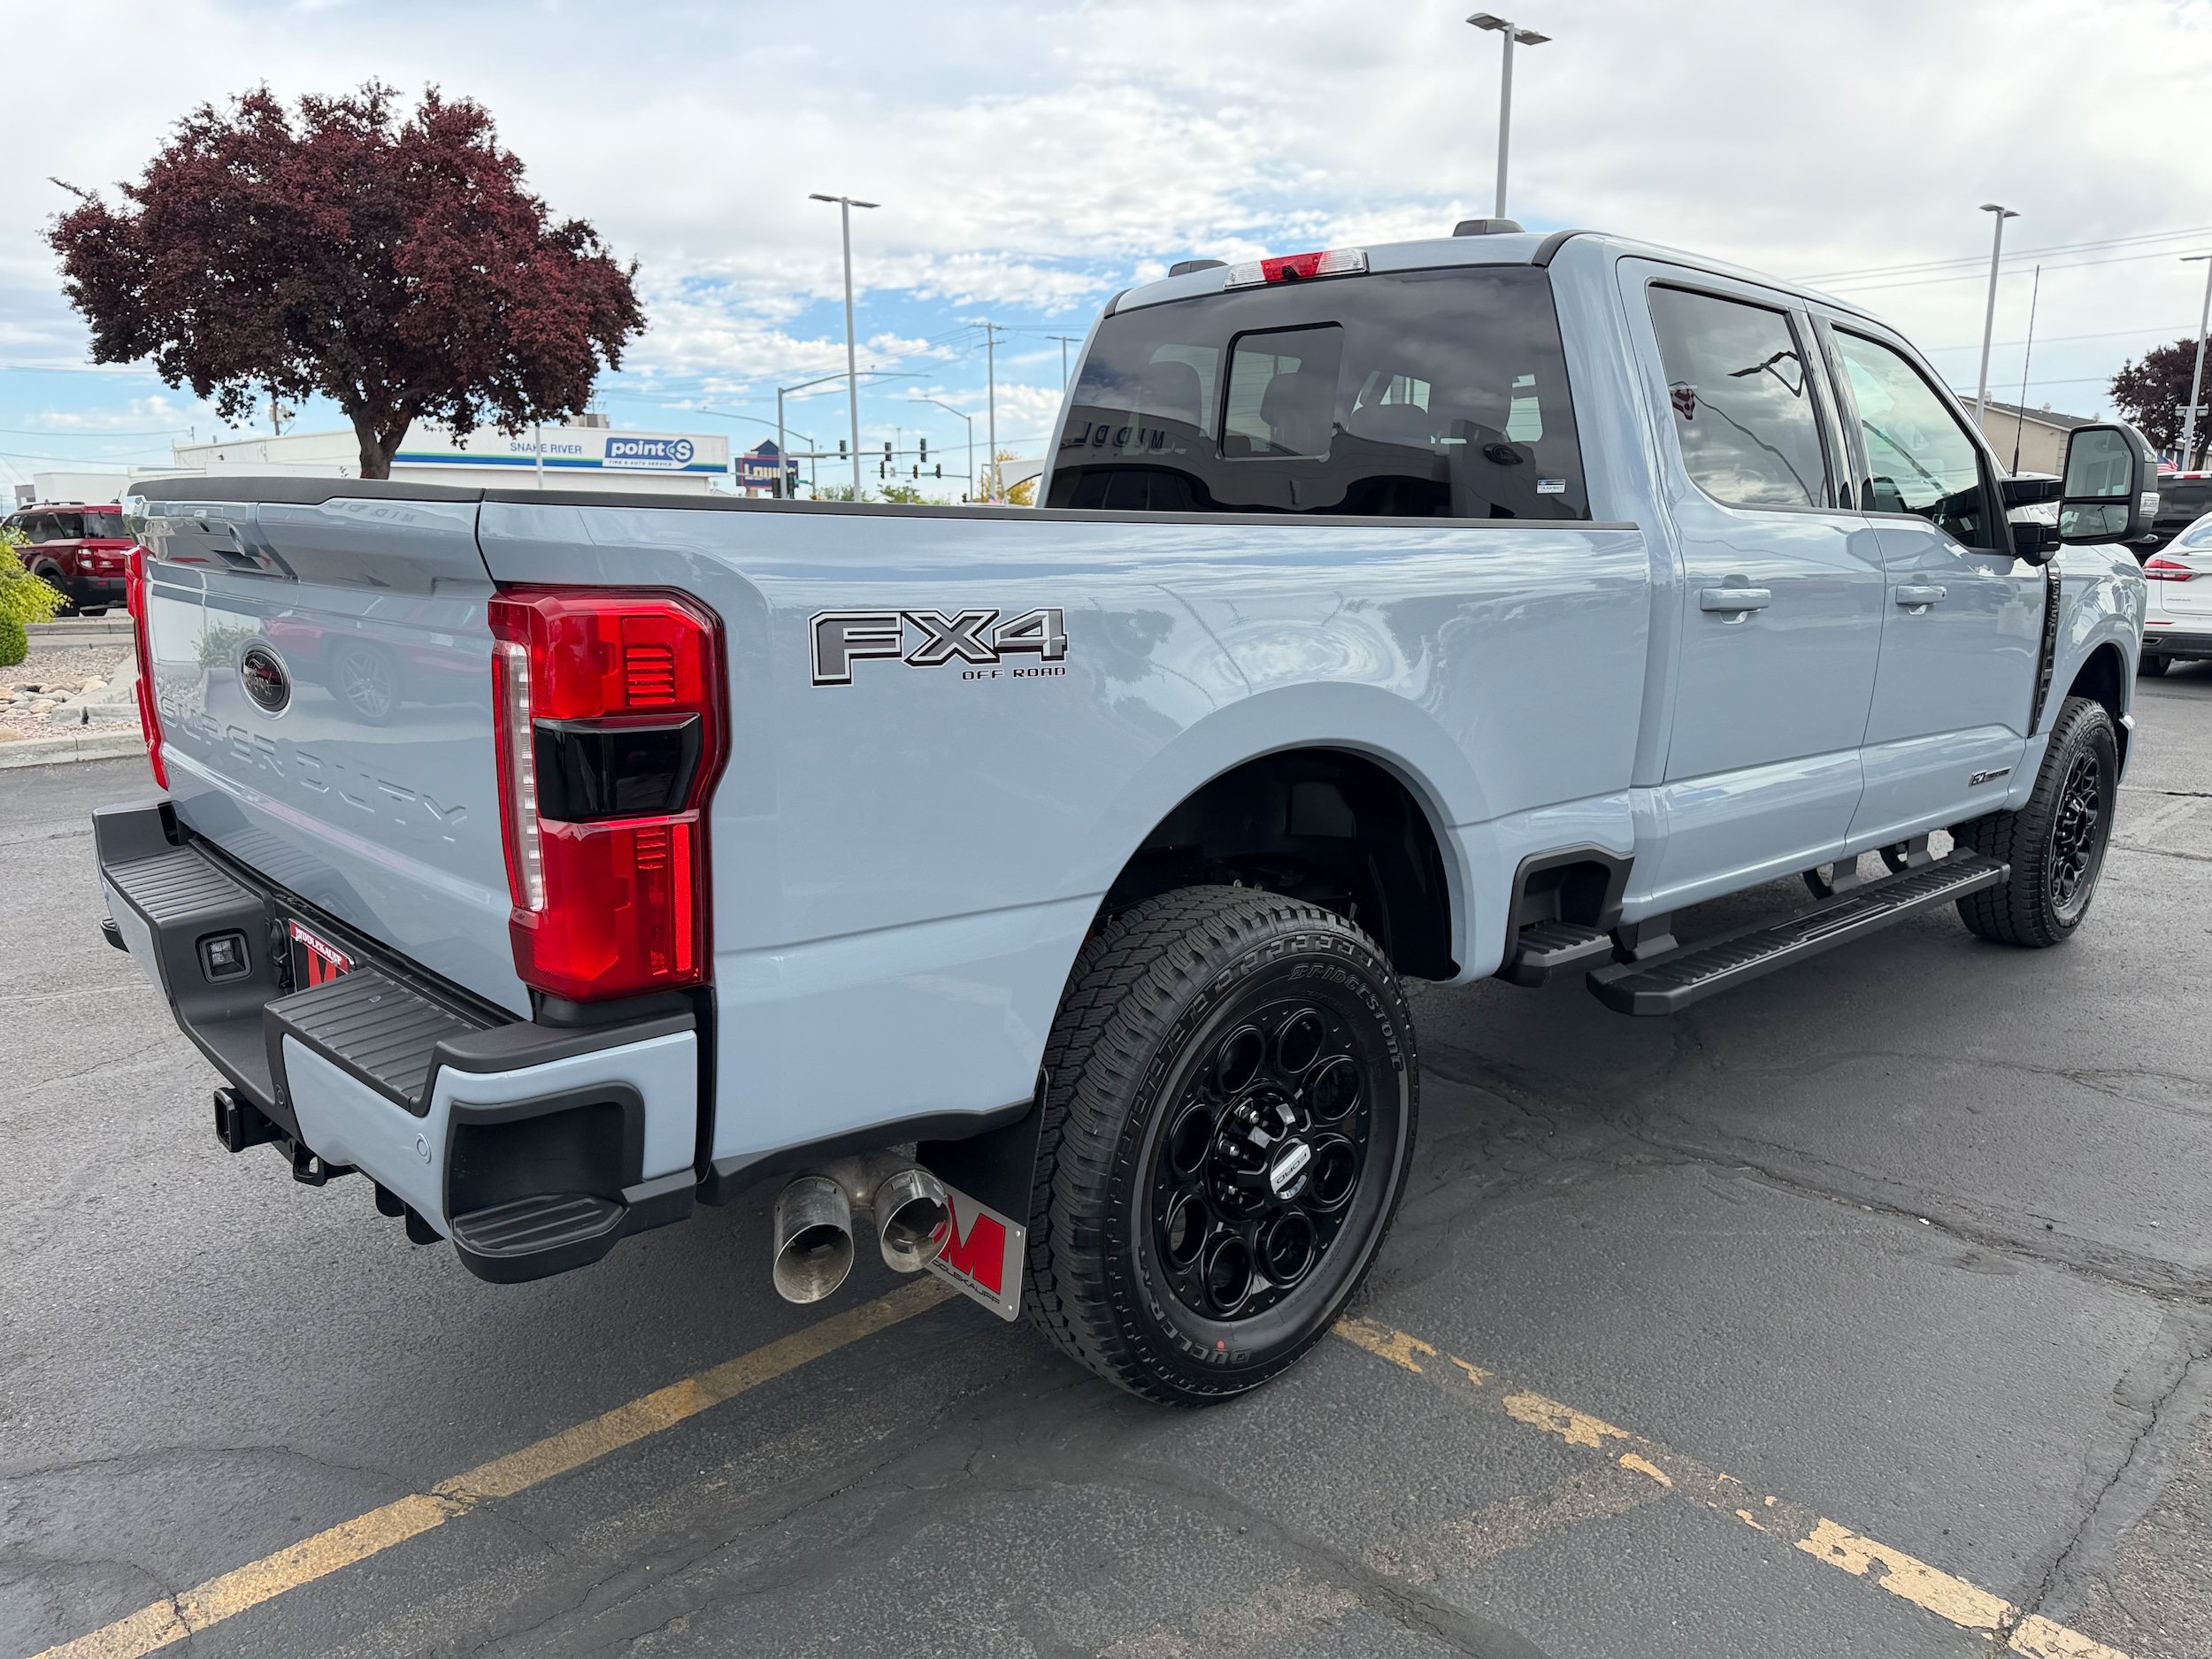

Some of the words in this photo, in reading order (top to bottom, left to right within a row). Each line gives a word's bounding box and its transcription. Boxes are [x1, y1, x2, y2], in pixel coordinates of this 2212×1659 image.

[550, 443, 582, 454] RIVER
[611, 441, 665, 457] point
[807, 607, 1070, 687] FX4
[962, 669, 1004, 680] OFF
[1012, 666, 1066, 679] ROAD
[1287, 963, 1404, 1072] BRIDGESTONE
[1276, 1151, 1308, 1184] FORD
[931, 1258, 1002, 1305] DDLEKAUFF
